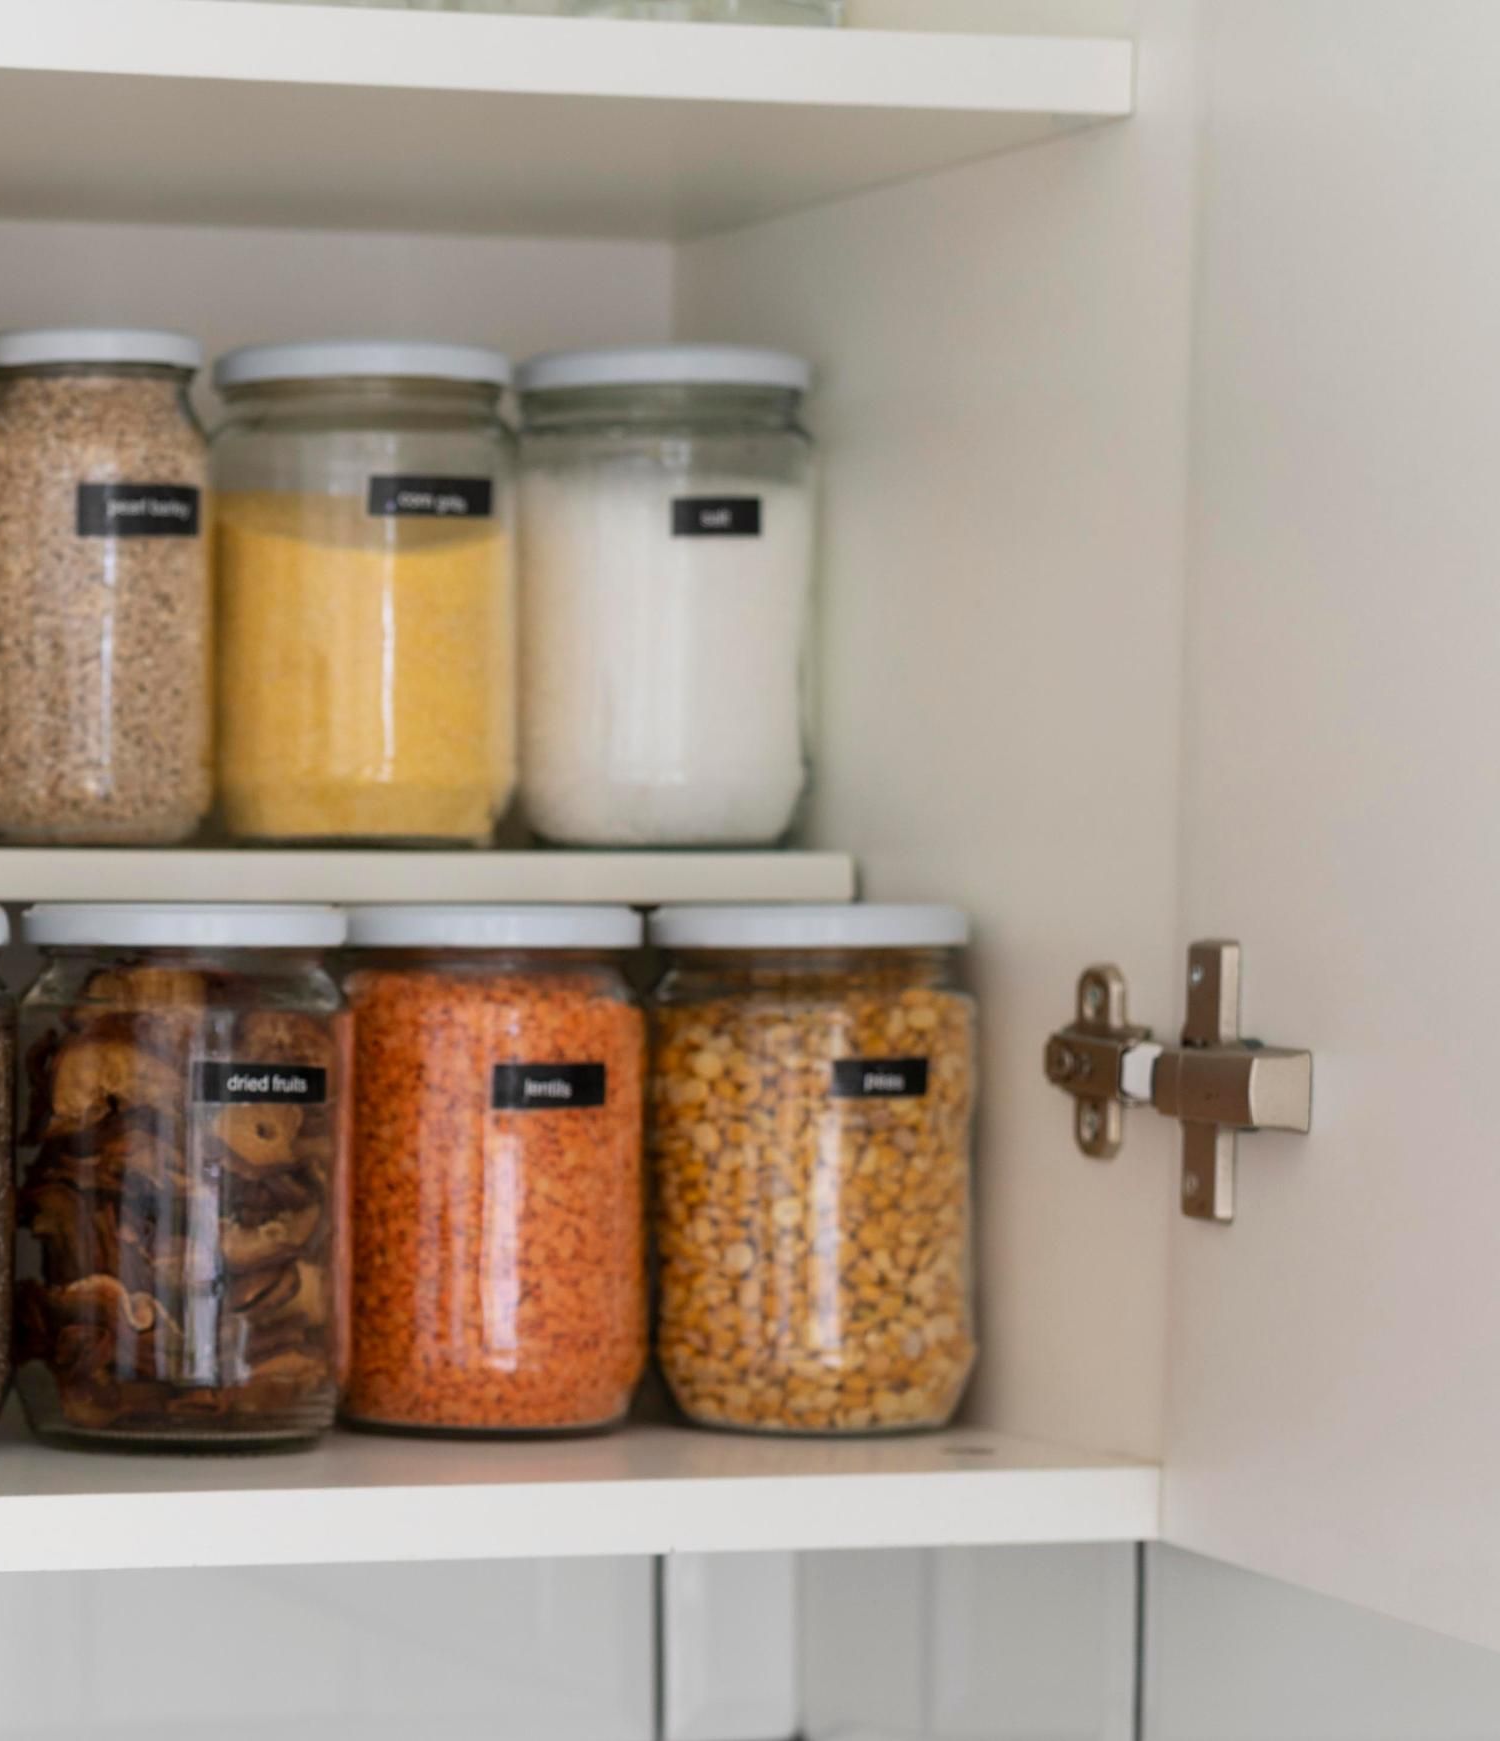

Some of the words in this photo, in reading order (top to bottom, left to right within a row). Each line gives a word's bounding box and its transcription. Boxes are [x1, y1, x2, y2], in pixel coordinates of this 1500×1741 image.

[226, 1074, 269, 1092] dried
[272, 1074, 309, 1093] fruits
[523, 1076, 573, 1099] lentils
